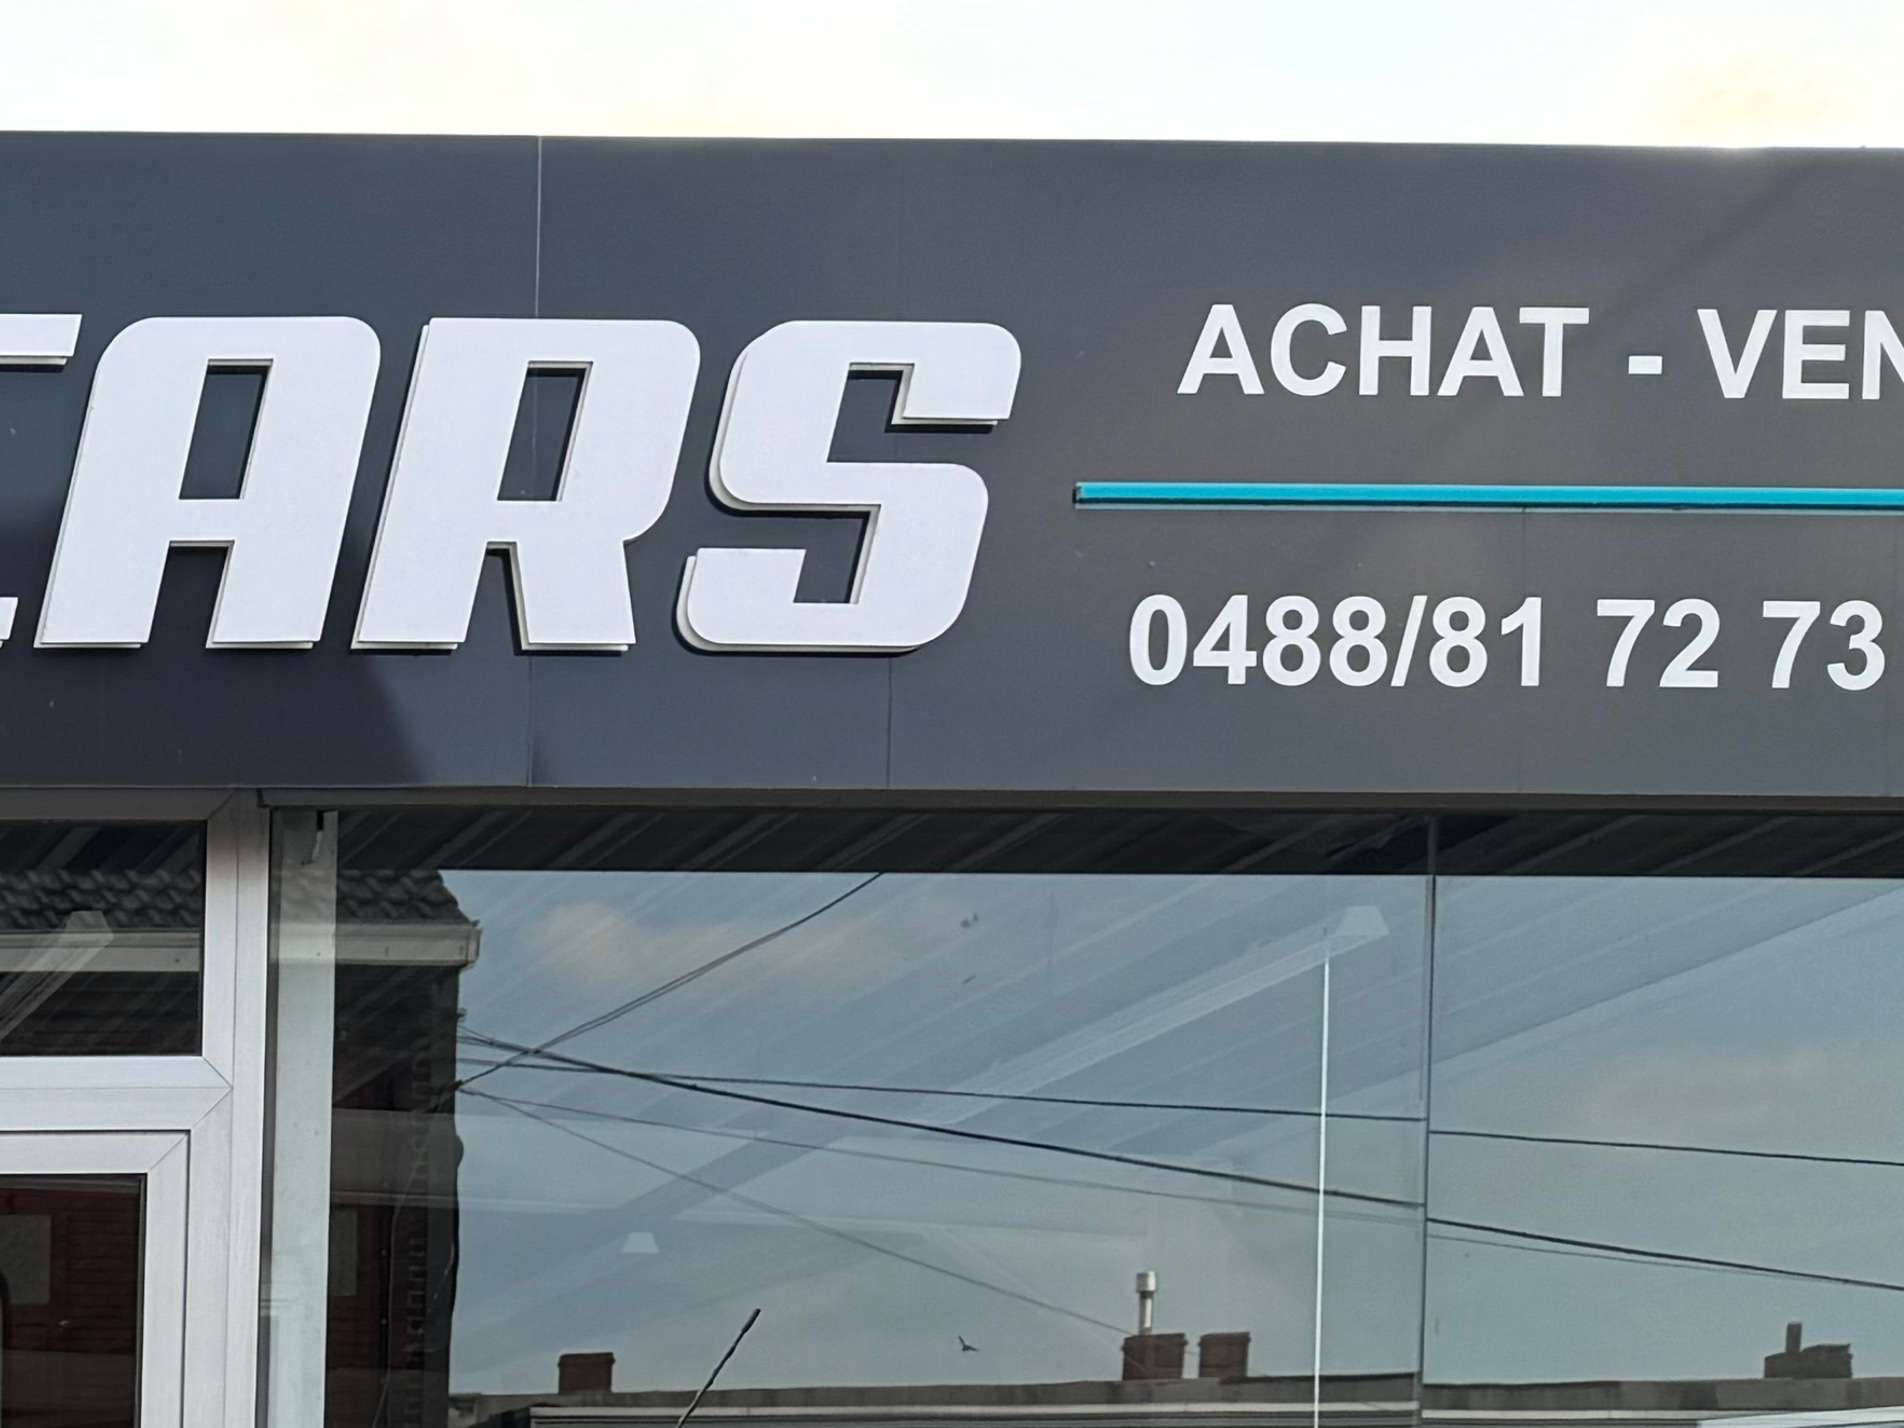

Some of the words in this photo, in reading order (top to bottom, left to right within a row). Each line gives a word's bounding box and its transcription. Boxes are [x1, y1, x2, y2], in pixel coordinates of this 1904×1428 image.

[1176, 302, 1590, 398] ACHAT
[1627, 354, 1663, 376] -
[1696, 307, 1904, 400] VEN
[1128, 593, 1544, 688] 0488/81
[1595, 598, 1721, 690] 72
[1761, 599, 1886, 691] 73
